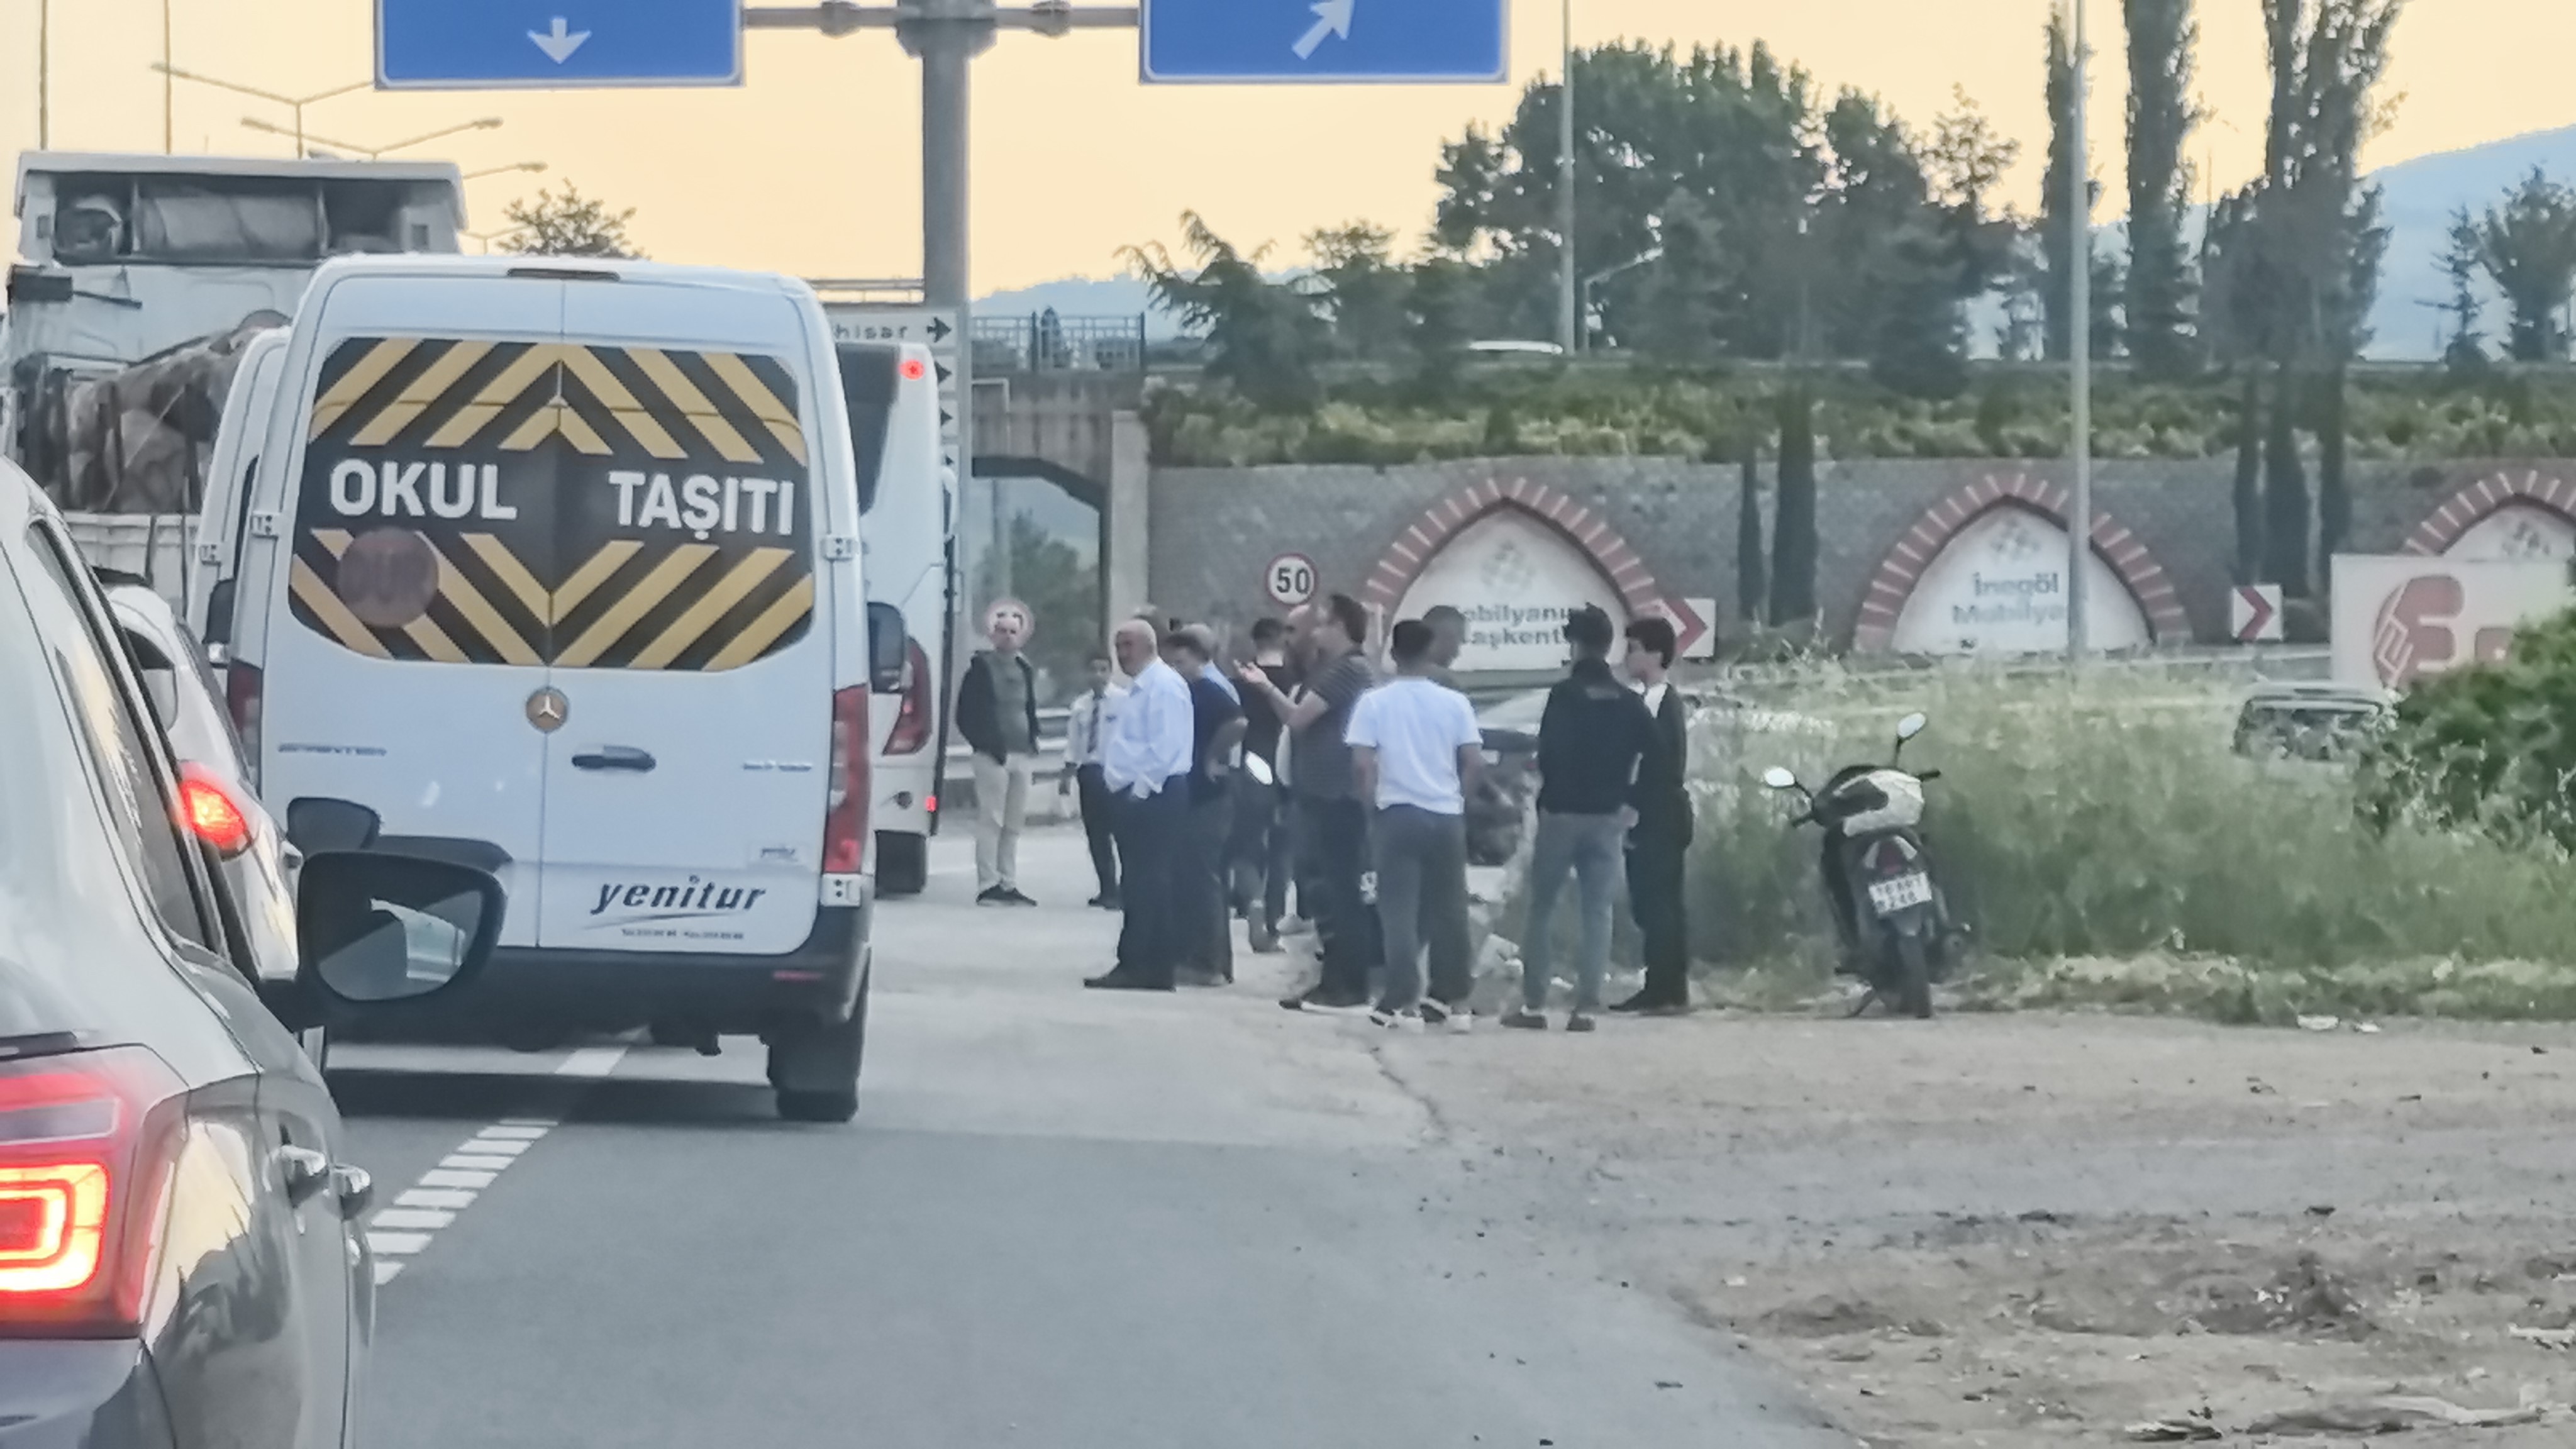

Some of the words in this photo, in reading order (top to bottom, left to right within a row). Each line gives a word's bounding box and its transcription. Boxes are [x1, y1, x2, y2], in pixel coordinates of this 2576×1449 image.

[834, 324, 908, 340] hisar
[330, 458, 518, 521] OKUL
[608, 470, 794, 540] TAŞITI
[1276, 567, 1311, 596] 50
[590, 874, 767, 916] yenitur
